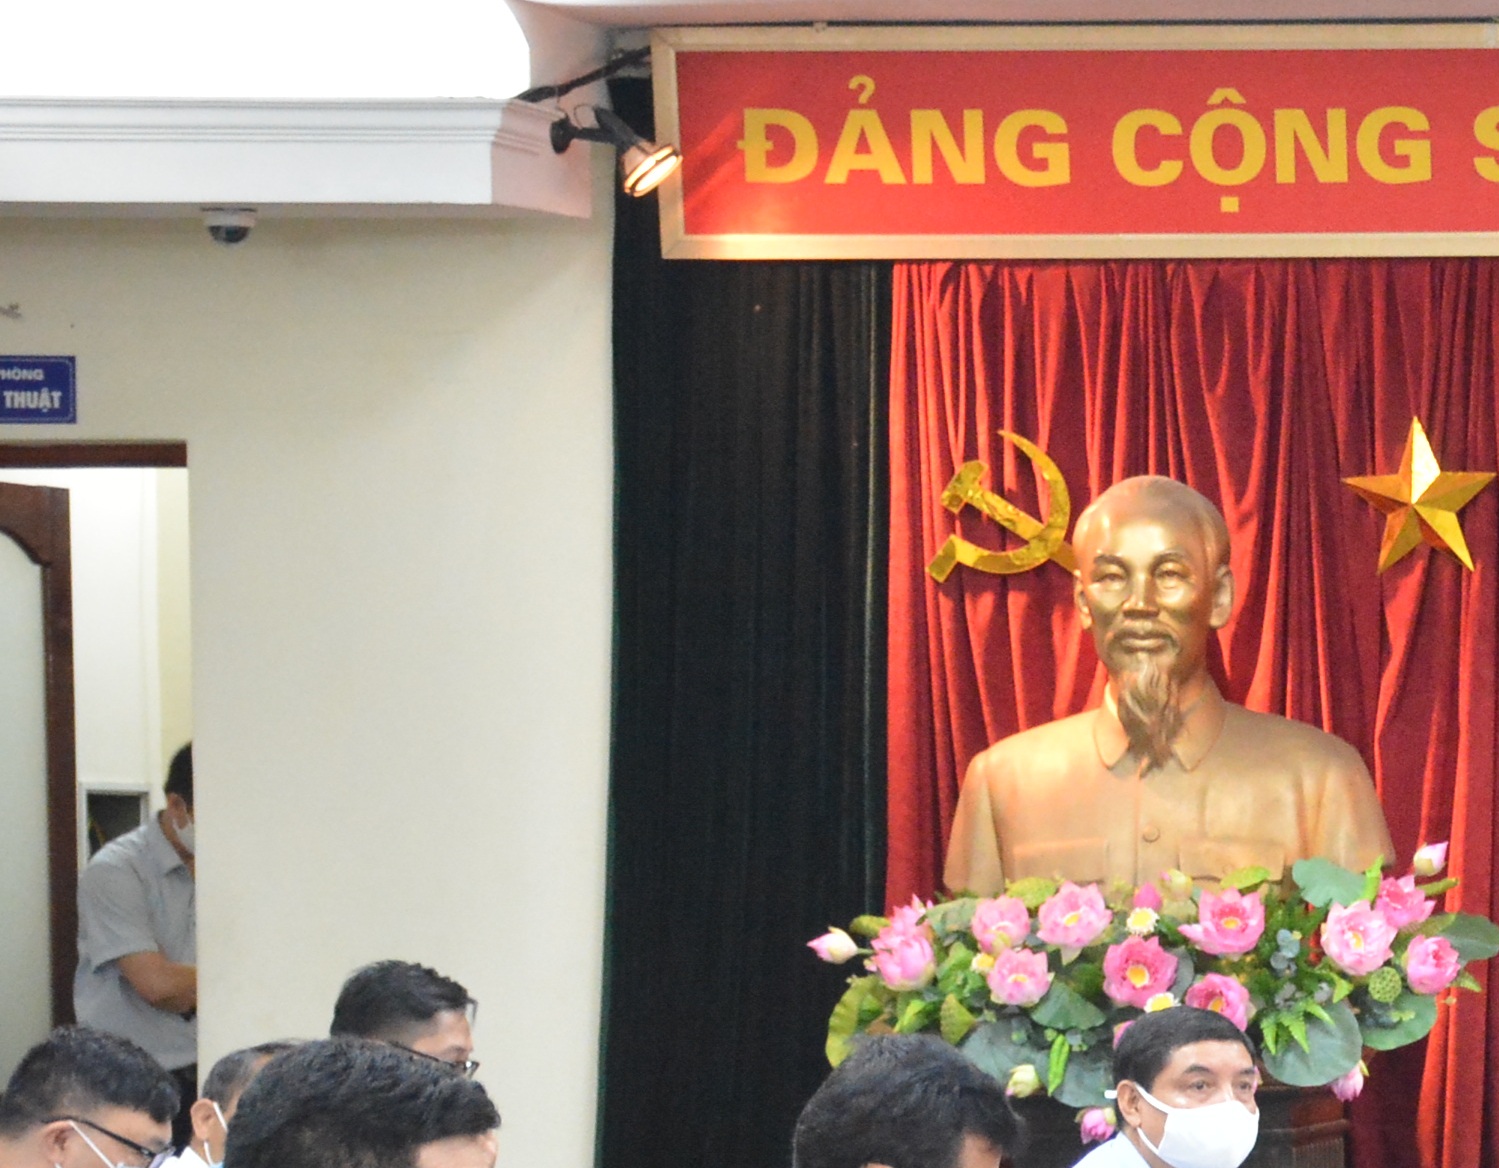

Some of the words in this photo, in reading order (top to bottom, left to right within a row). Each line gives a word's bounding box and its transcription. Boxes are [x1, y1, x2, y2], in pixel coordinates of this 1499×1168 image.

[740, 77, 1070, 186] ĐẢNG
[1113, 89, 1431, 212] CỘNG
[0, 367, 44, 380] HÒNG
[3, 387, 62, 412] THUẬT
